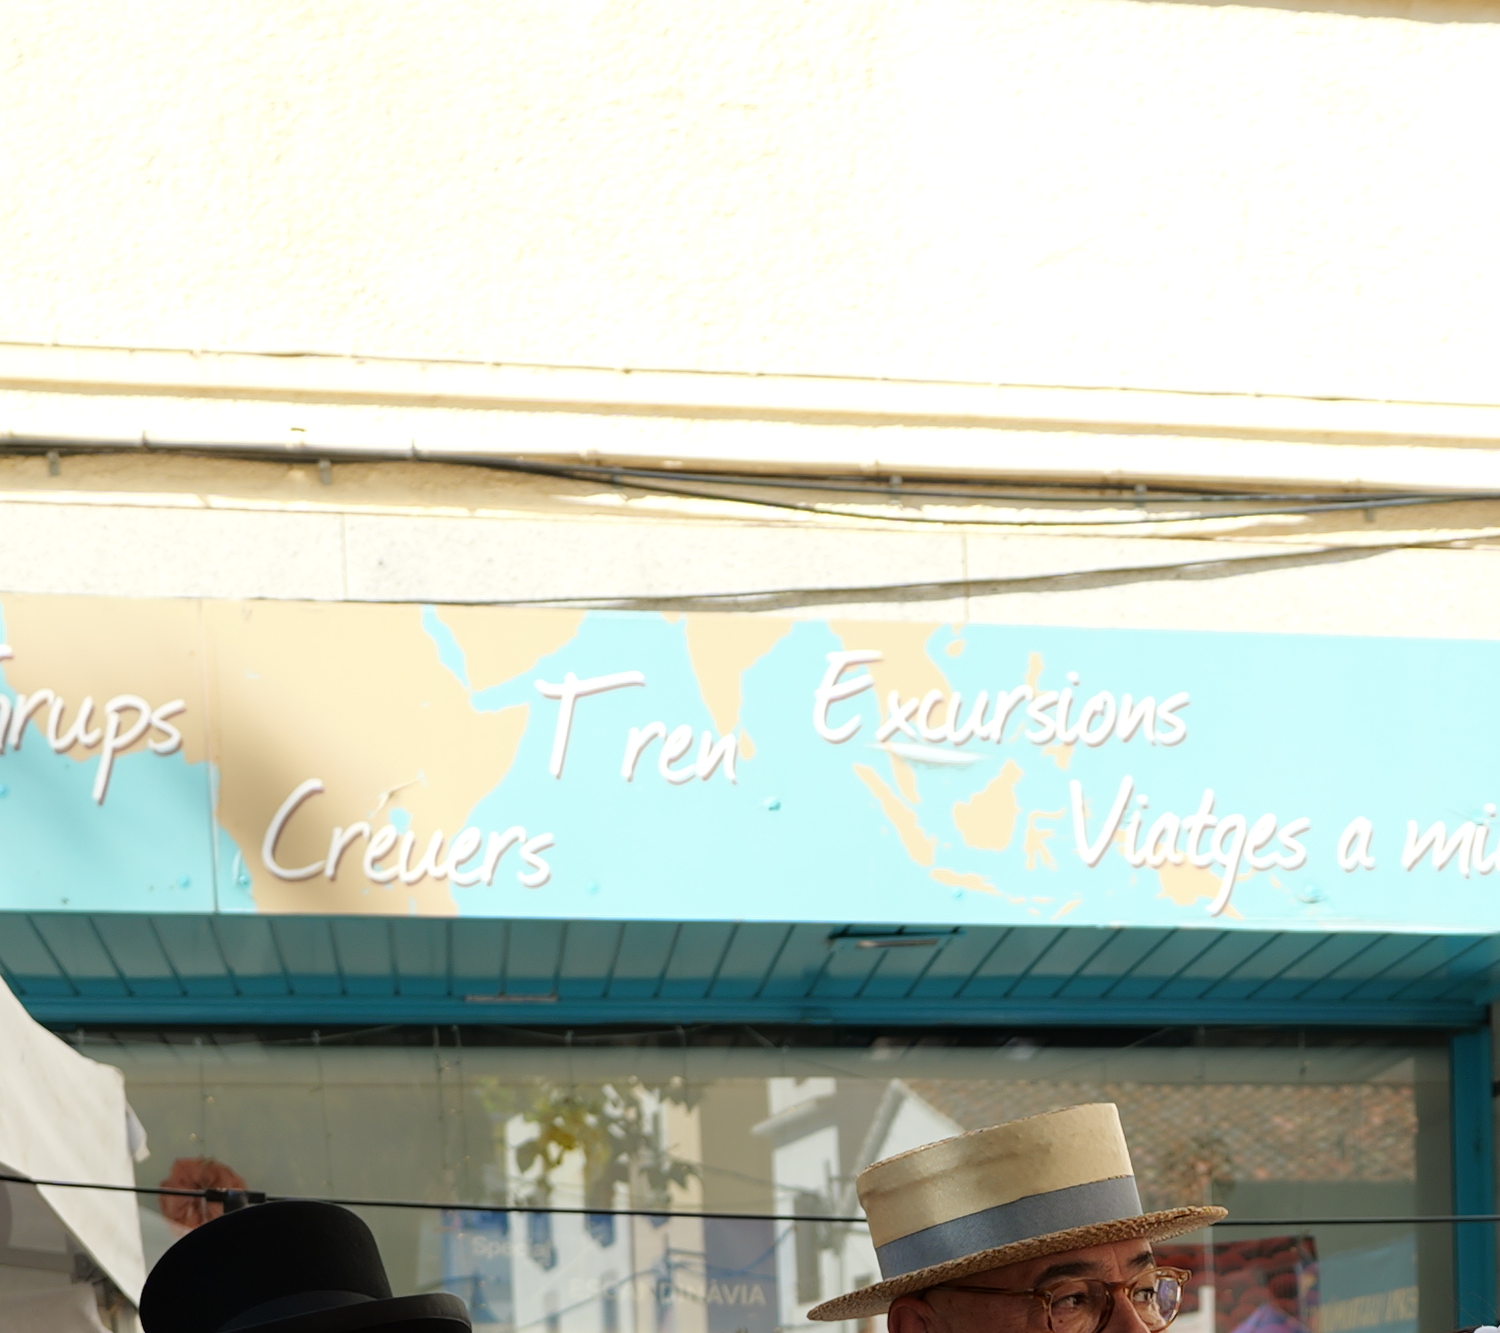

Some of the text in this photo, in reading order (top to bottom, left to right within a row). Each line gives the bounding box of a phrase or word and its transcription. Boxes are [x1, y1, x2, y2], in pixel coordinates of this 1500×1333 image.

[534, 670, 737, 785] Tren
[813, 649, 1191, 748] Excursions
[261, 778, 555, 887] Creuers
[1069, 775, 1312, 917] Viatges
[1337, 816, 1376, 873] a
